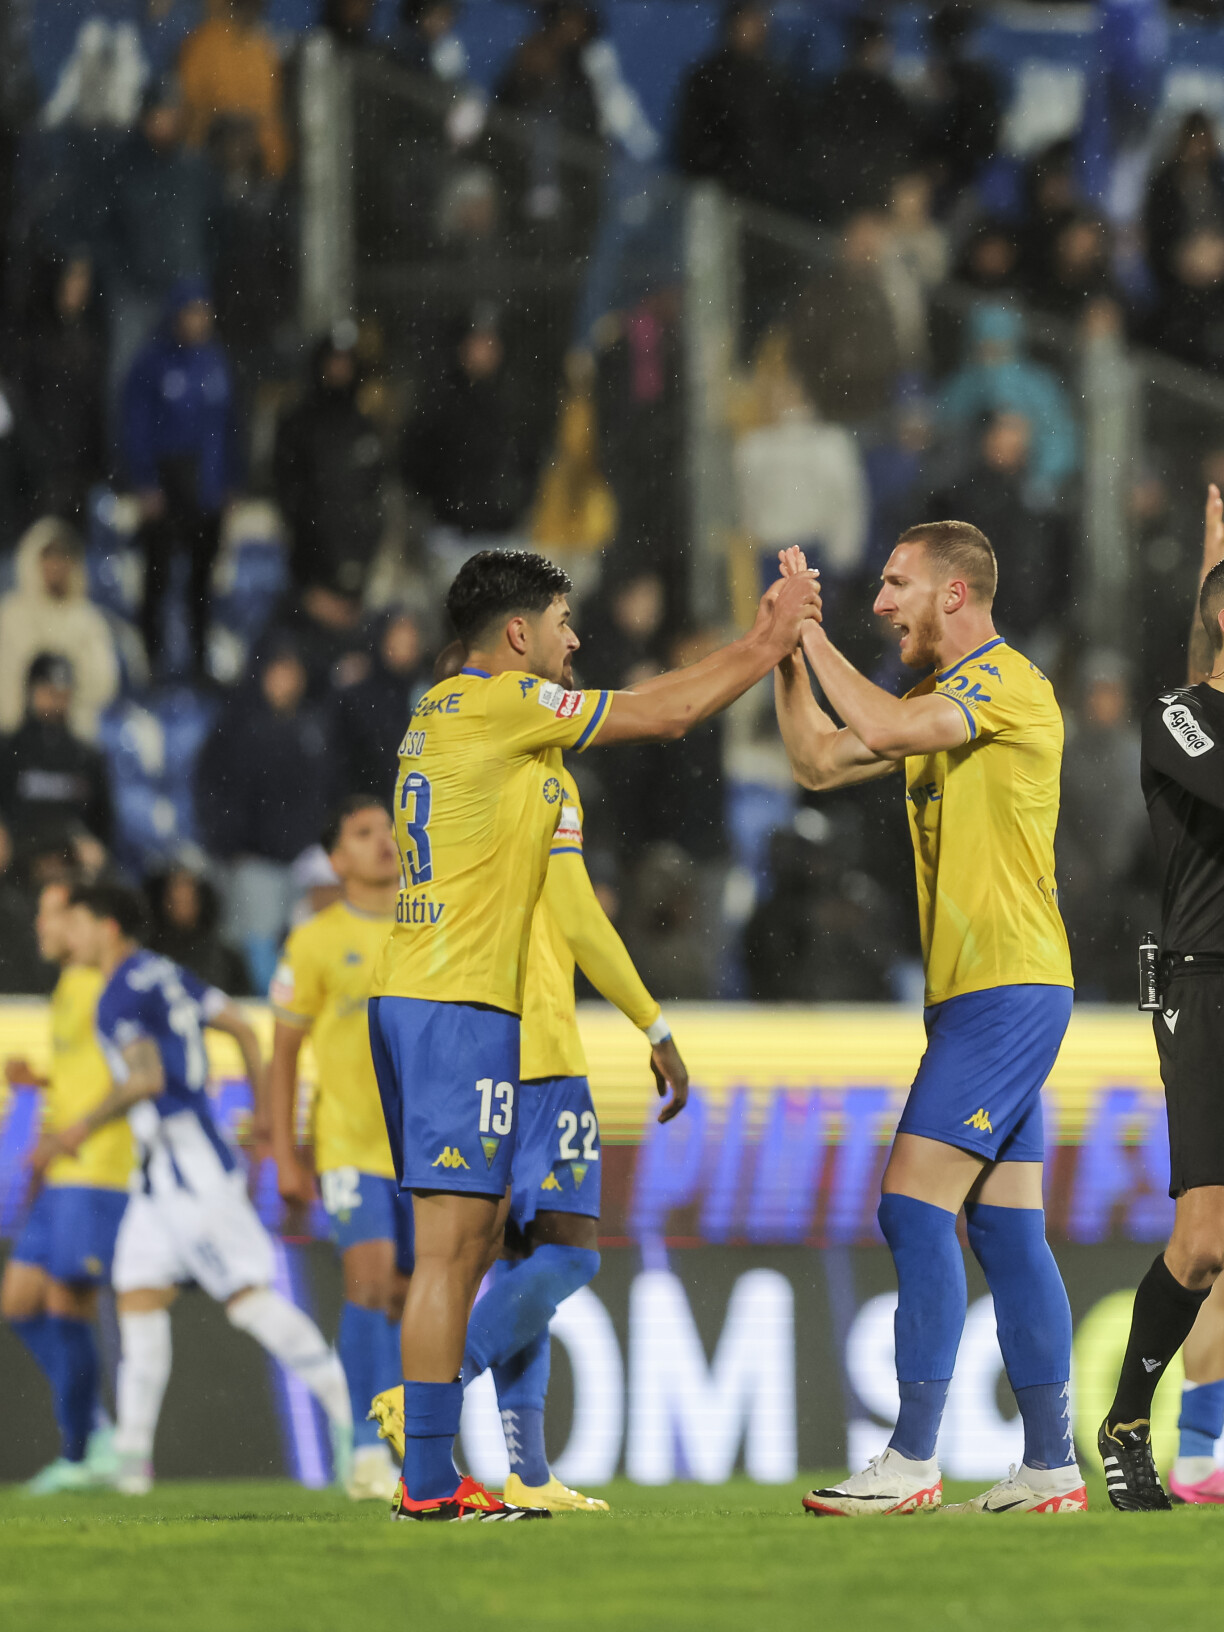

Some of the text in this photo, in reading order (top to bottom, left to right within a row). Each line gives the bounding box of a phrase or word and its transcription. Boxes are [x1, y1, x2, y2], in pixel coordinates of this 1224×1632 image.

[1169, 710, 1207, 751] Agriloja
[394, 771, 433, 889] 3
[475, 1077, 515, 1136] 13
[557, 1110, 600, 1161] 22
